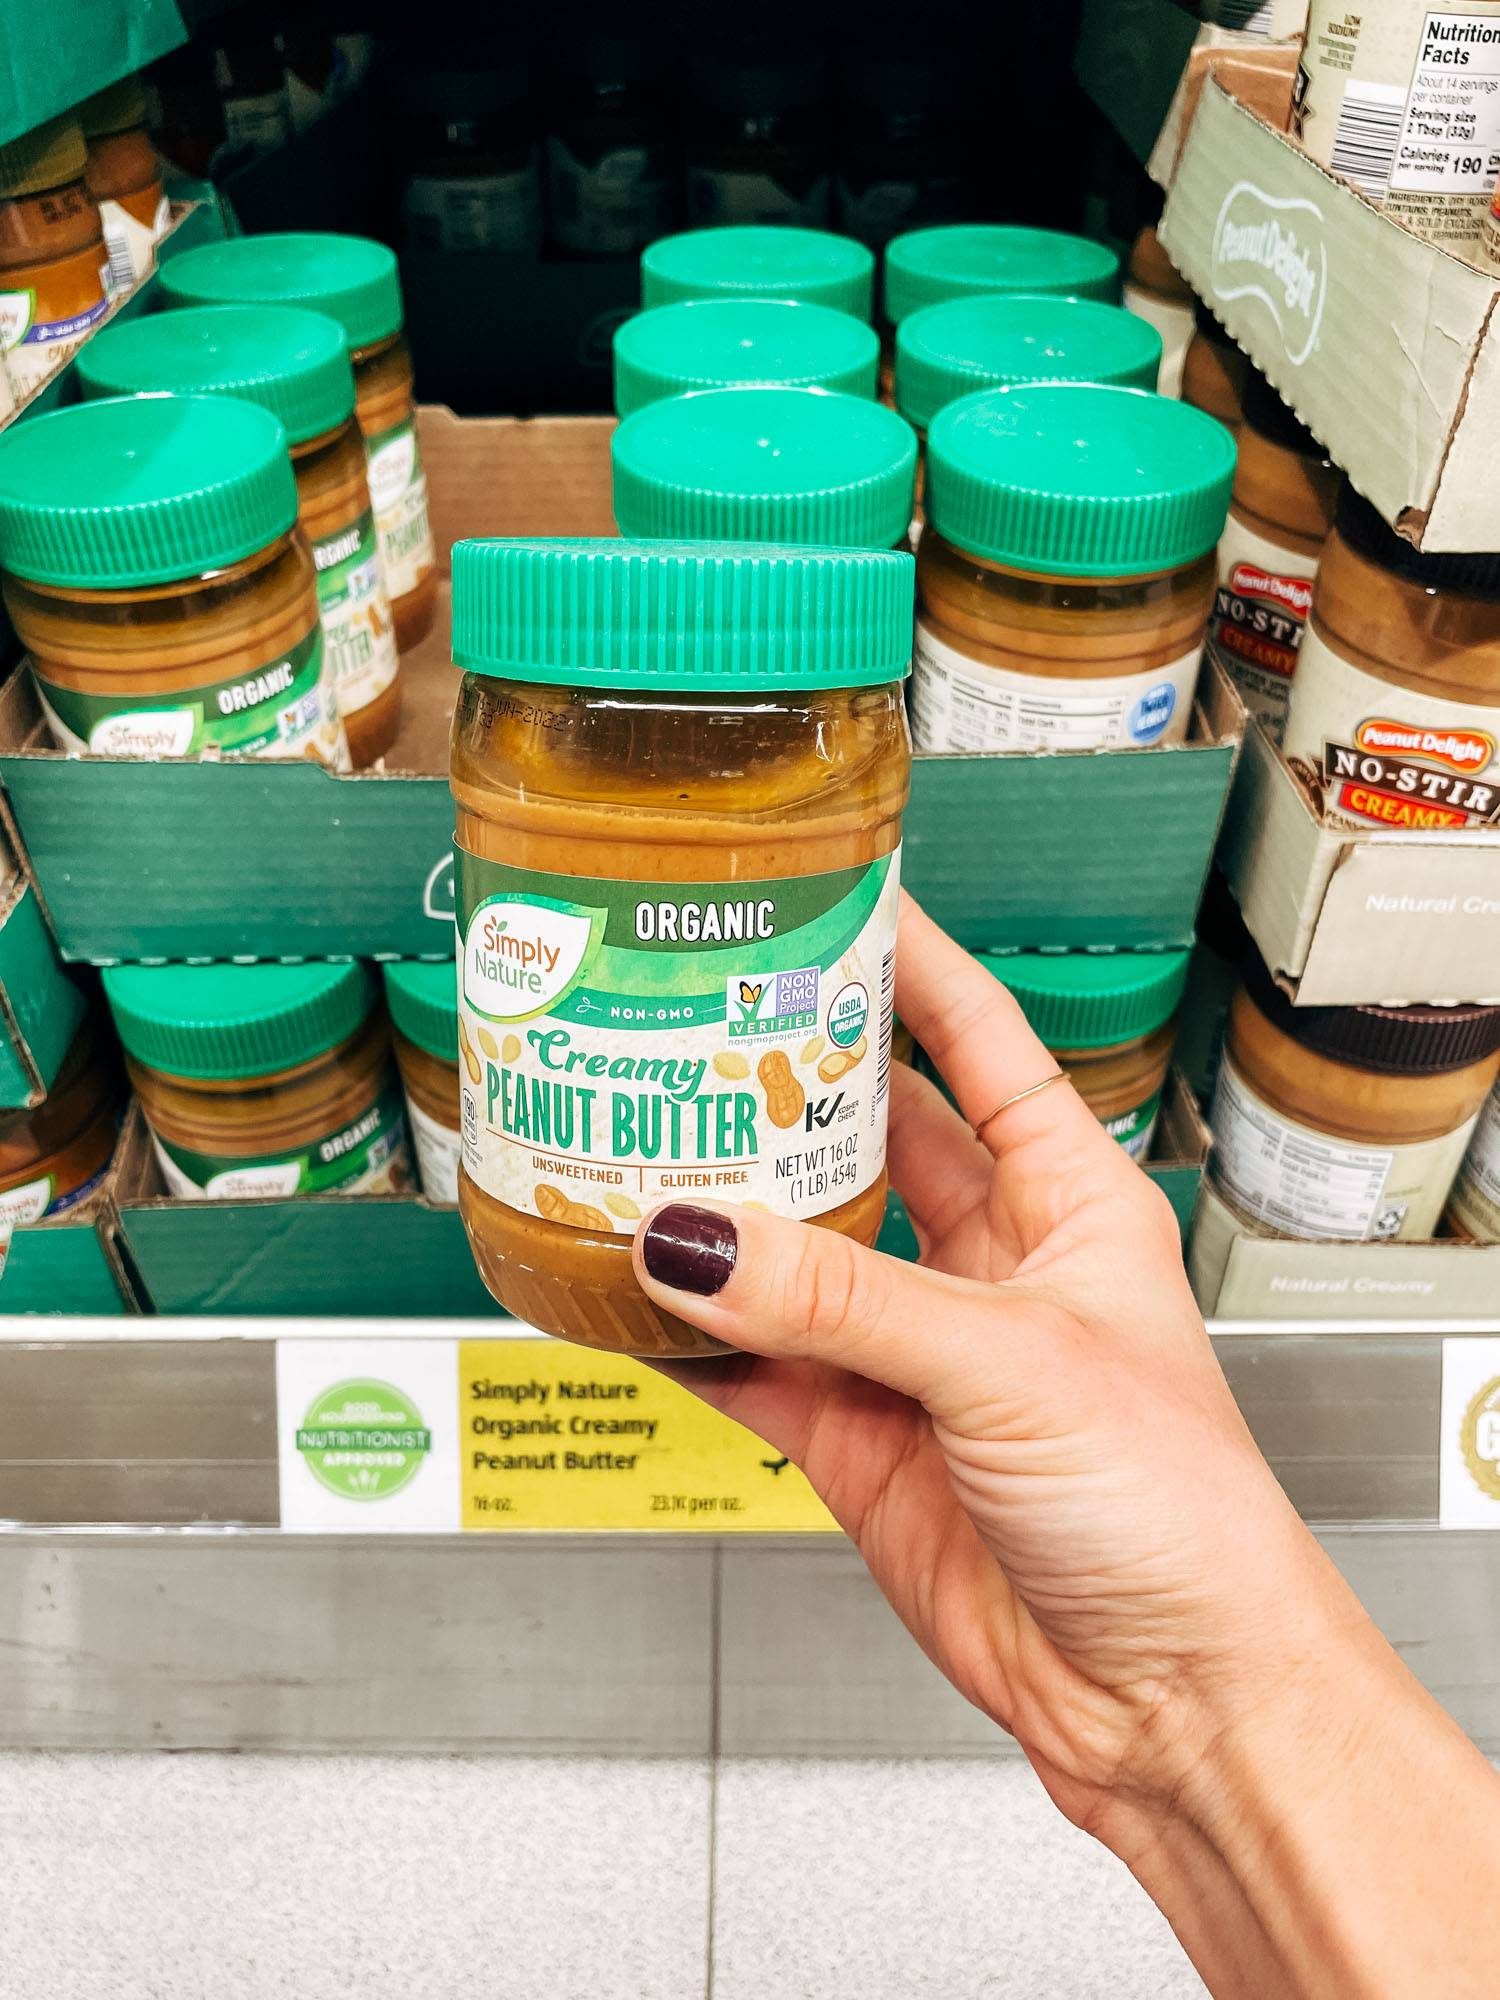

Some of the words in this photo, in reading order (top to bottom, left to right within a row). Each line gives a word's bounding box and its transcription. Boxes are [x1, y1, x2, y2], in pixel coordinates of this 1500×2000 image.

[1427, 21, 1500, 43] Nutrition
[1422, 44, 1470, 65] Facts
[1401, 146, 1450, 162] Calories
[1454, 157, 1482, 174] 190
[1217, 592, 1304, 648] NO-STI
[217, 662, 294, 715] ORGANIC
[1334, 748, 1493, 812] NO-STIR
[1462, 895, 1500, 914] Cre
[635, 899, 775, 942] ORGANIC
[483, 918, 560, 973] Simply
[475, 949, 542, 994] Nature
[781, 972, 815, 989] NON
[780, 986, 816, 1003] GMO
[838, 996, 862, 1017] USDA
[610, 1006, 694, 1020] NON-GMO
[779, 1000, 815, 1015] Project
[733, 1014, 815, 1035] VERIFIED
[834, 1013, 864, 1035] ORGANIC
[527, 1029, 707, 1102] Creamy
[486, 1061, 597, 1153] PEANUT
[612, 1091, 758, 1160] BUTTER
[775, 1153, 802, 1180] NET
[804, 1147, 826, 1172] WT
[829, 1141, 842, 1163] 16
[845, 1133, 858, 1156] OZ
[532, 1155, 623, 1185] UNSWEETENED
[660, 1174, 712, 1188] GLUTEN
[715, 1171, 748, 1186] FREE
[789, 1179, 804, 1204] (1
[808, 1171, 828, 1198] LB)
[831, 1162, 857, 1187] 454g
[471, 1379, 549, 1404] Simply
[558, 1381, 638, 1400] Nature
[472, 1416, 561, 1440] Organic
[569, 1416, 658, 1439] Creamy
[473, 1452, 556, 1471] Peanut
[565, 1452, 637, 1471] Butter
